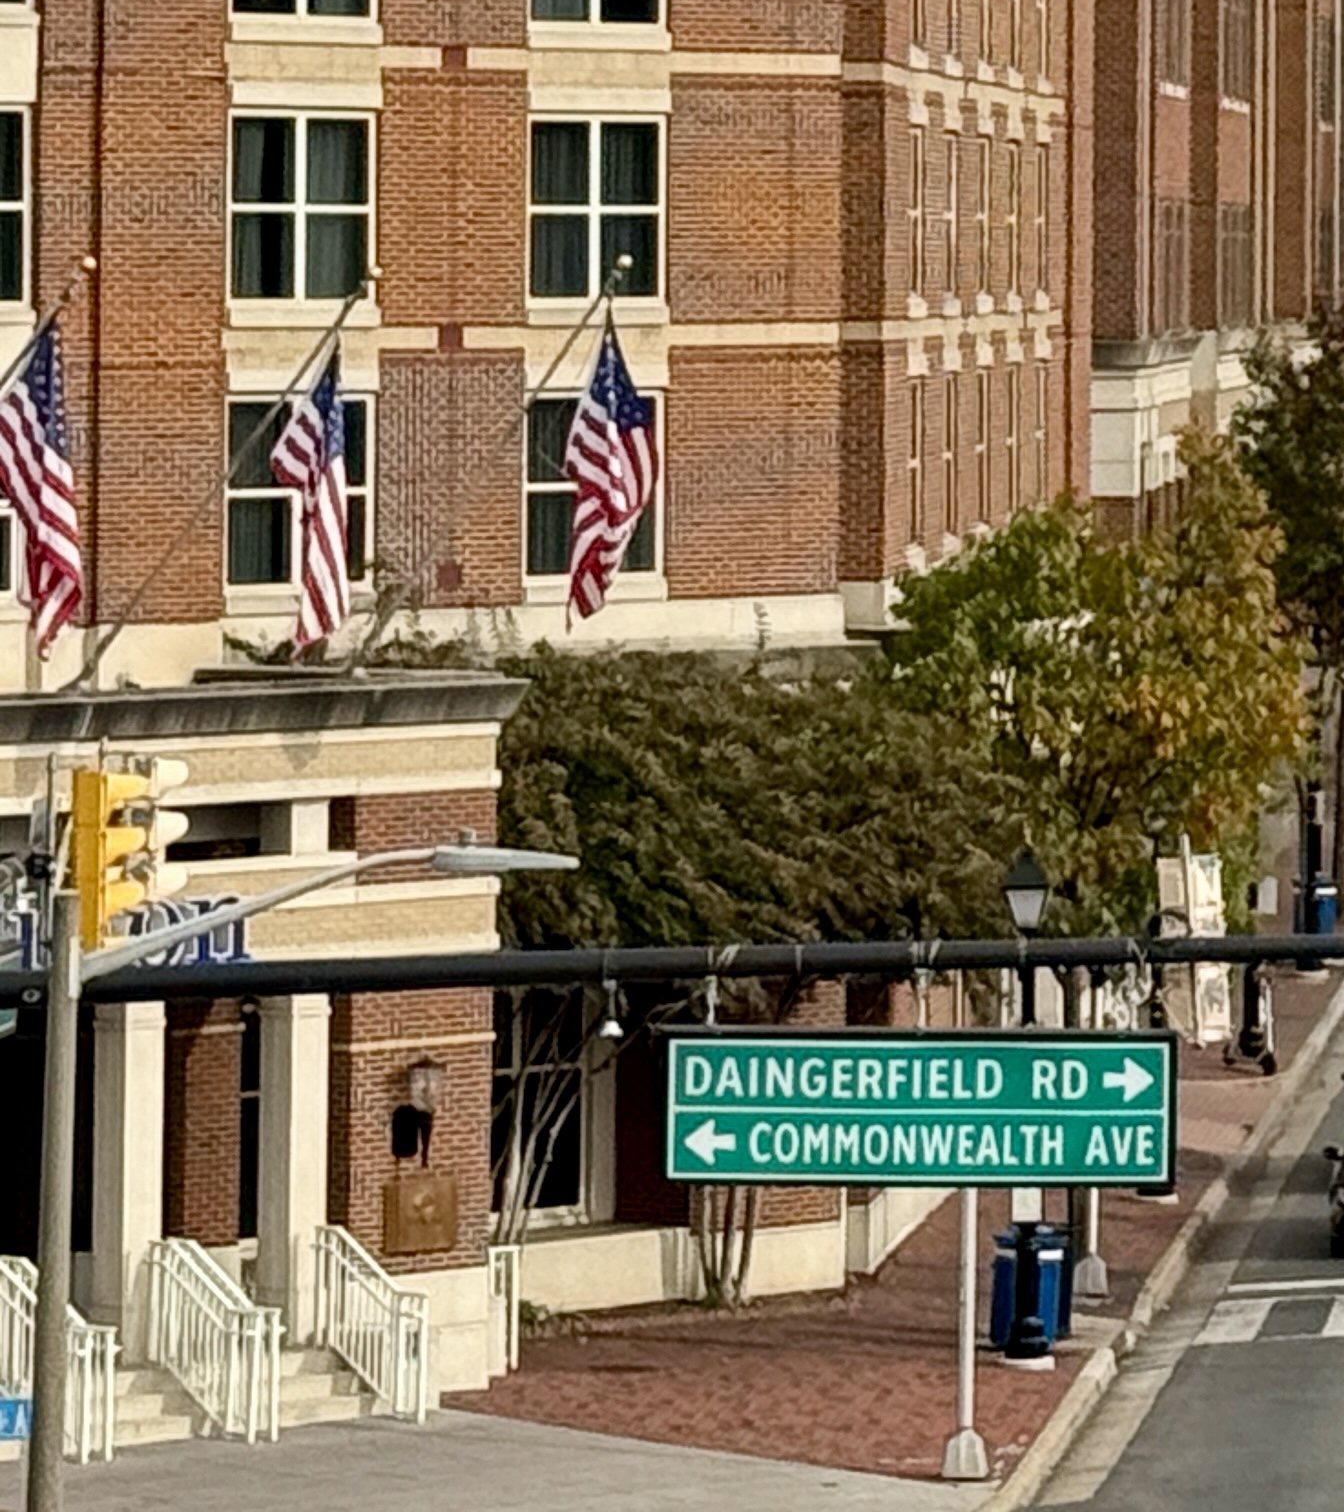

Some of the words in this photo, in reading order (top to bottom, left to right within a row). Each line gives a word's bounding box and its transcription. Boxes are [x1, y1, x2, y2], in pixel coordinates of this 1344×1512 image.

[683, 1057, 1003, 1100] DAINGERFIELD
[1032, 1058, 1090, 1100] RD
[748, 1121, 1064, 1166] COMMONWEALTH
[1084, 1125, 1154, 1166] AVE
